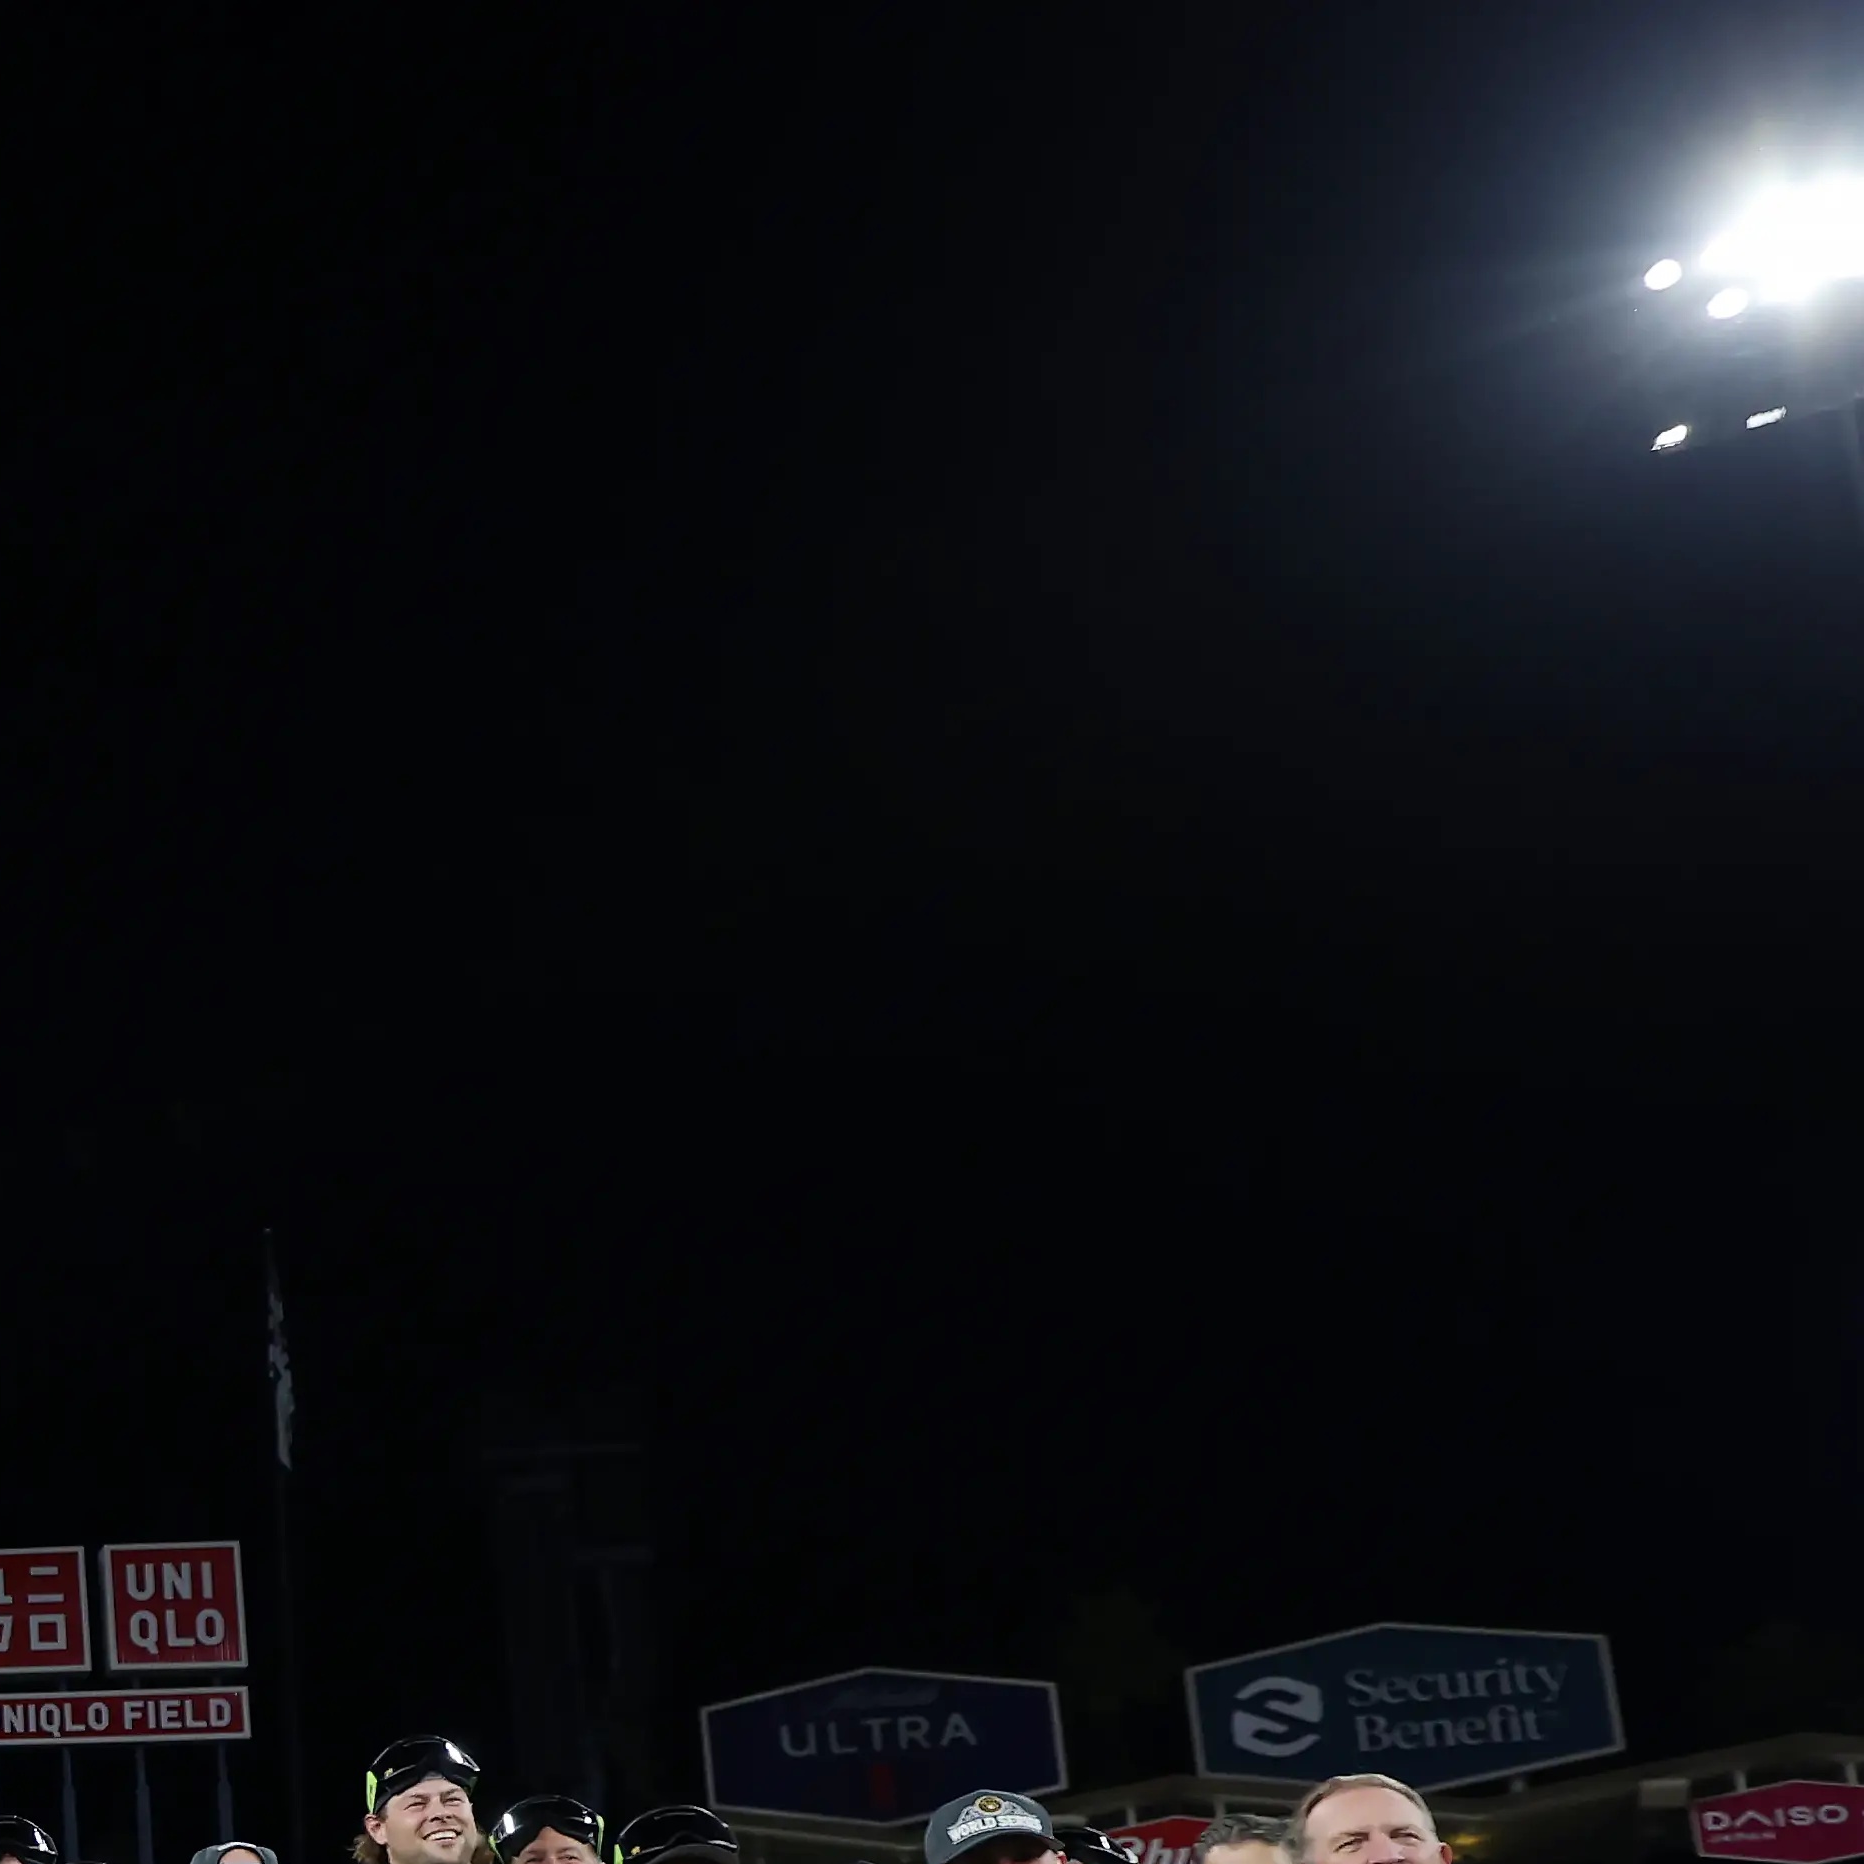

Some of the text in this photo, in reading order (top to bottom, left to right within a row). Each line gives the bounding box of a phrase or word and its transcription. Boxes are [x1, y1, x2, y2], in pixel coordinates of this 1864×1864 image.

[125, 1560, 213, 1601] UNI
[129, 1608, 226, 1655] QLO
[1346, 1656, 1569, 1707] Security
[124, 1698, 233, 1730] FIELD
[780, 1710, 980, 1760] ULTRA
[1355, 1701, 1548, 1754] Benefit
[1702, 1804, 1851, 1831] DAISO
